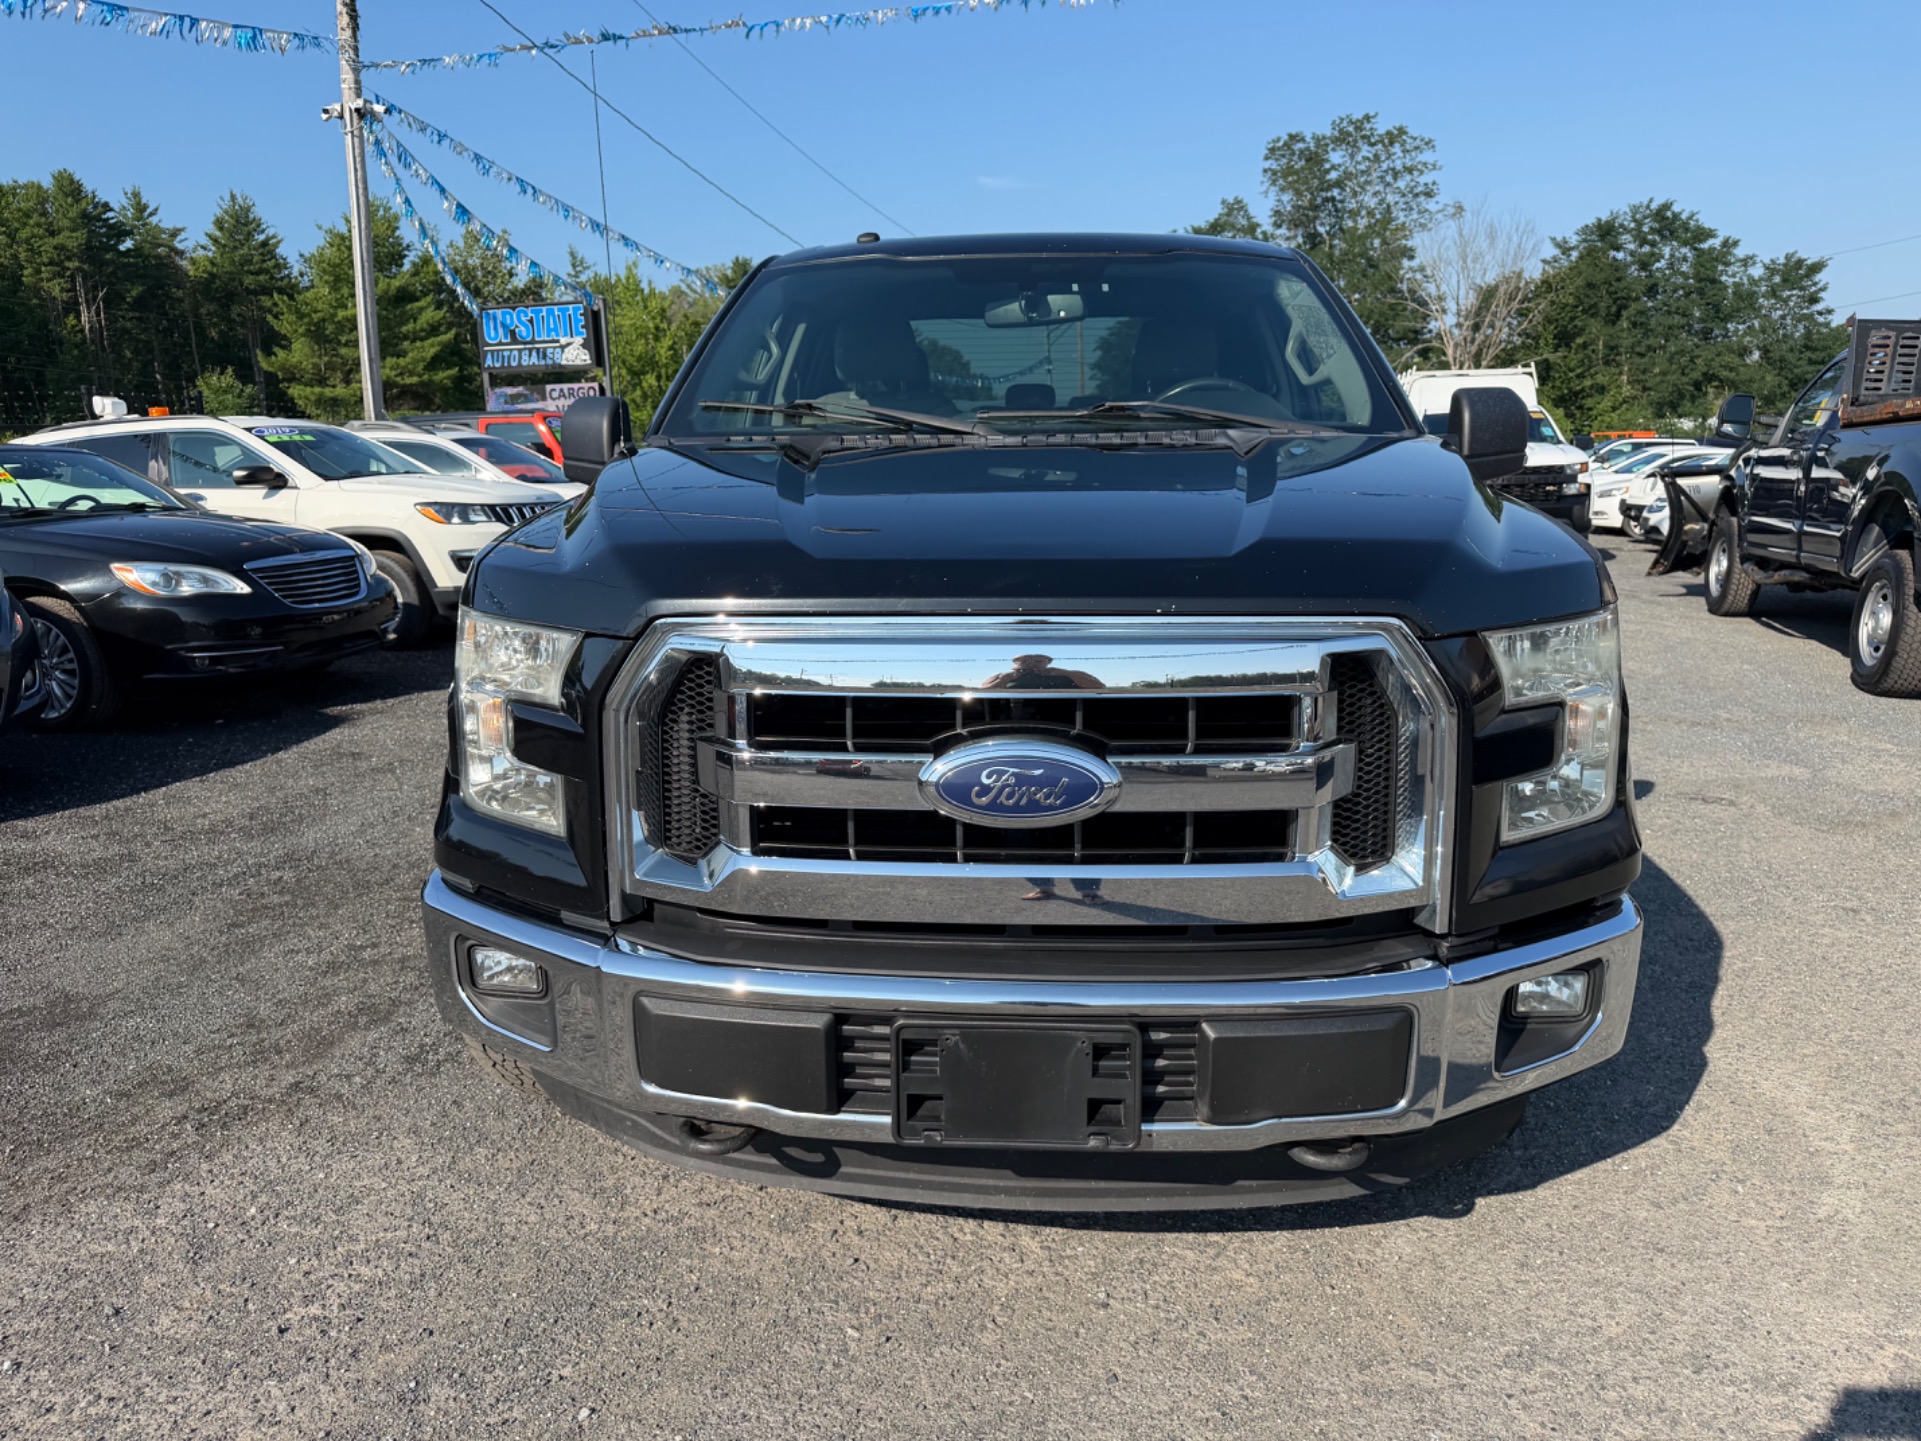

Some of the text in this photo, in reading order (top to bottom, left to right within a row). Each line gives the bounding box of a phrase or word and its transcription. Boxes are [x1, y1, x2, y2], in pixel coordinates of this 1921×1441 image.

[482, 304, 586, 343] UPSTATE
[484, 347, 562, 368] AUTO SALES
[548, 386, 597, 401] CARGO
[971, 766, 1069, 806] Ford
